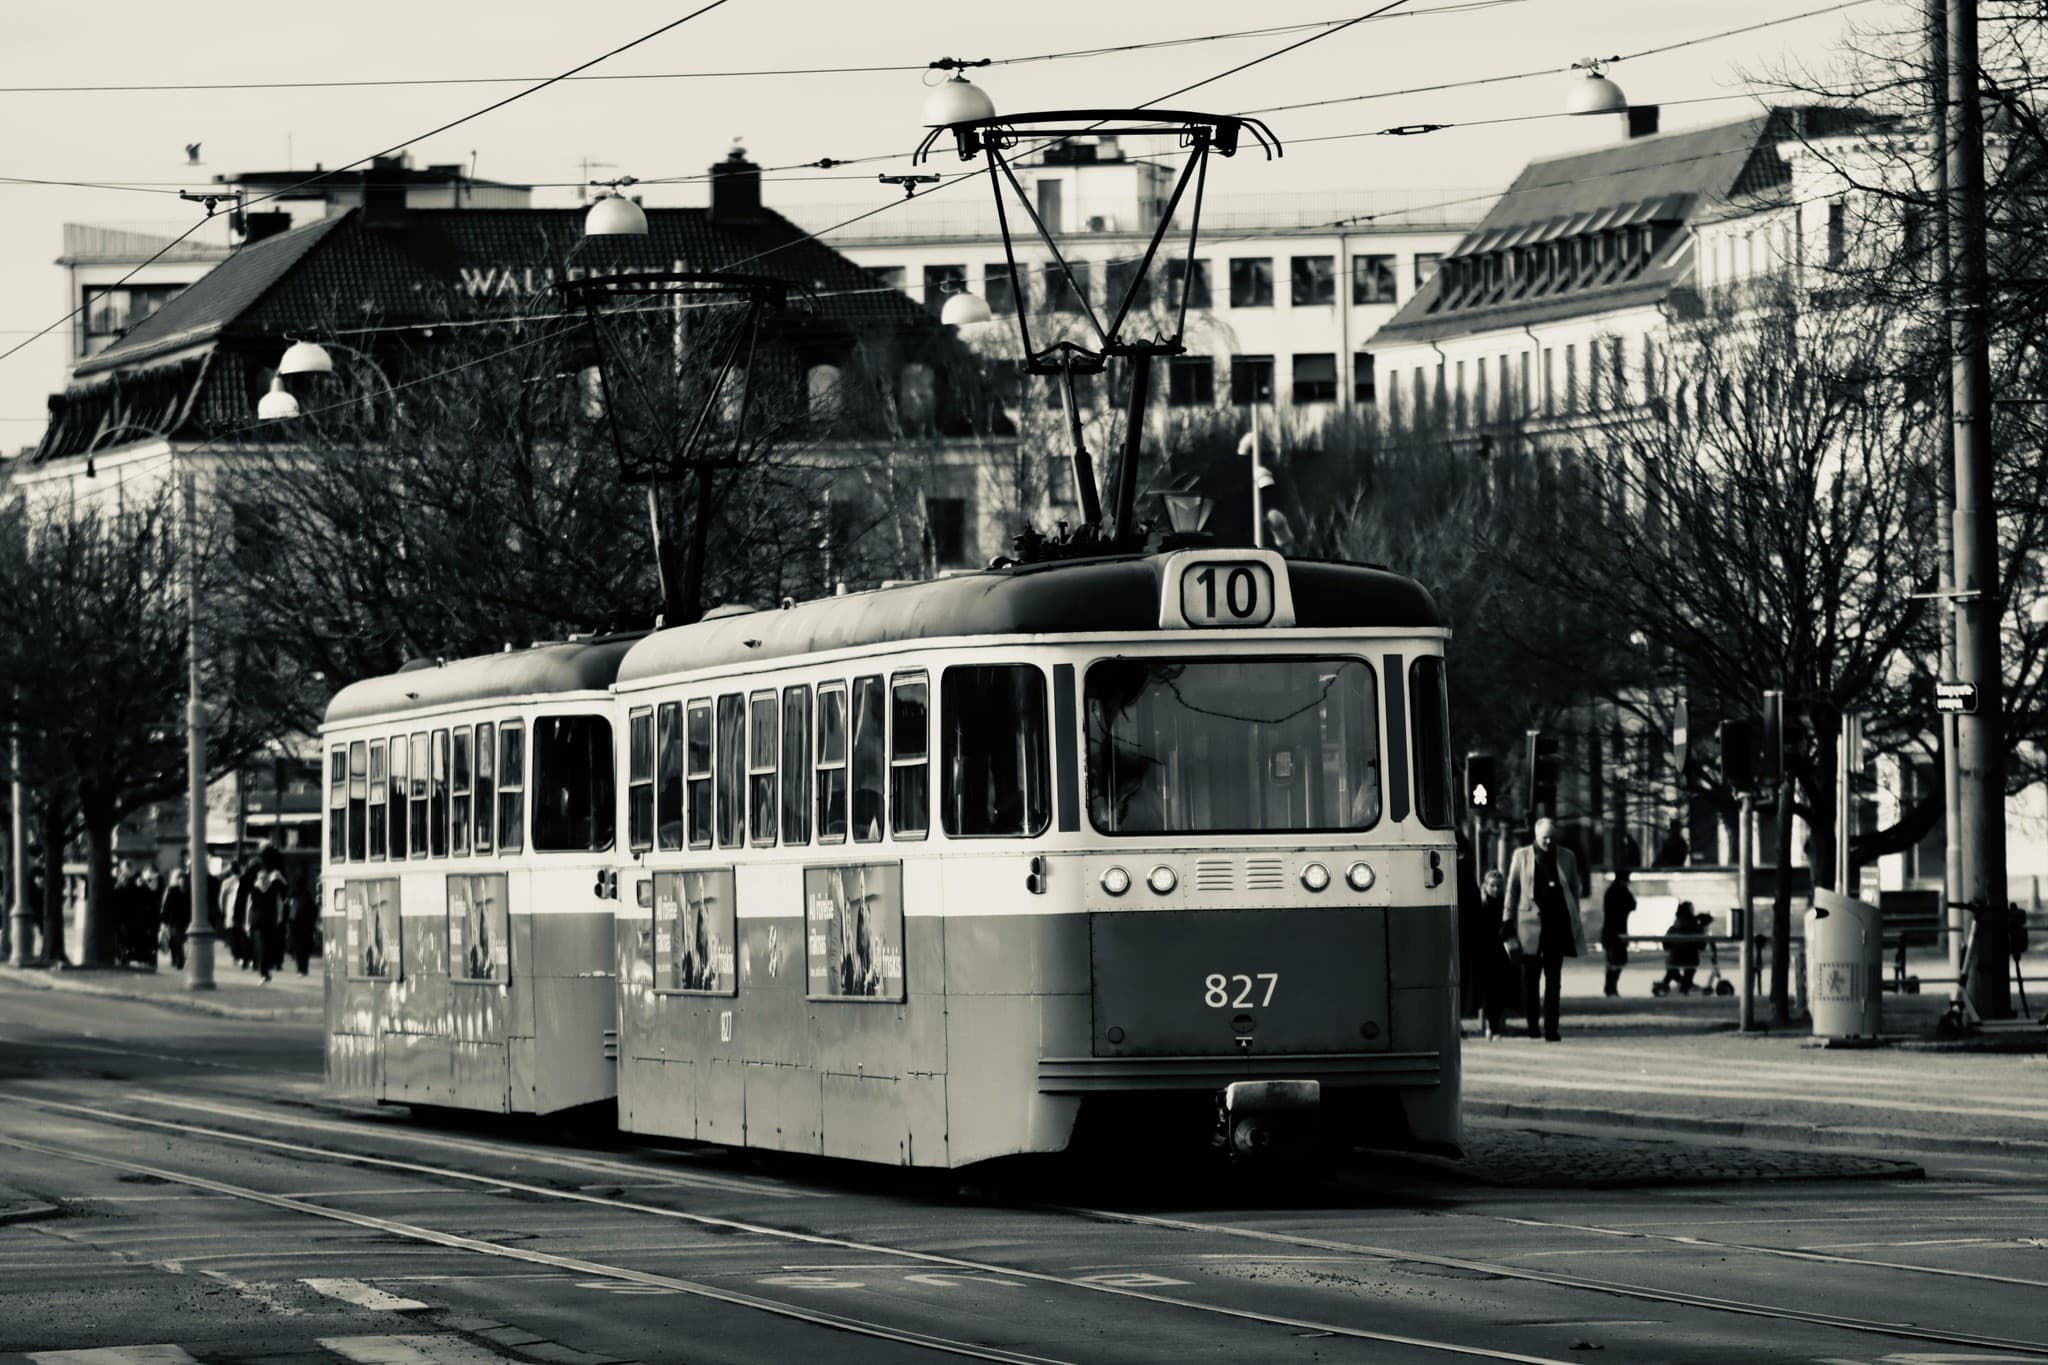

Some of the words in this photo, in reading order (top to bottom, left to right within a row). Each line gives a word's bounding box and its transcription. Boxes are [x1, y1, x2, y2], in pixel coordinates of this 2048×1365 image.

[1196, 567, 1257, 618] 10
[1205, 973, 1279, 1008] 827
[721, 1010, 732, 1042] 827
